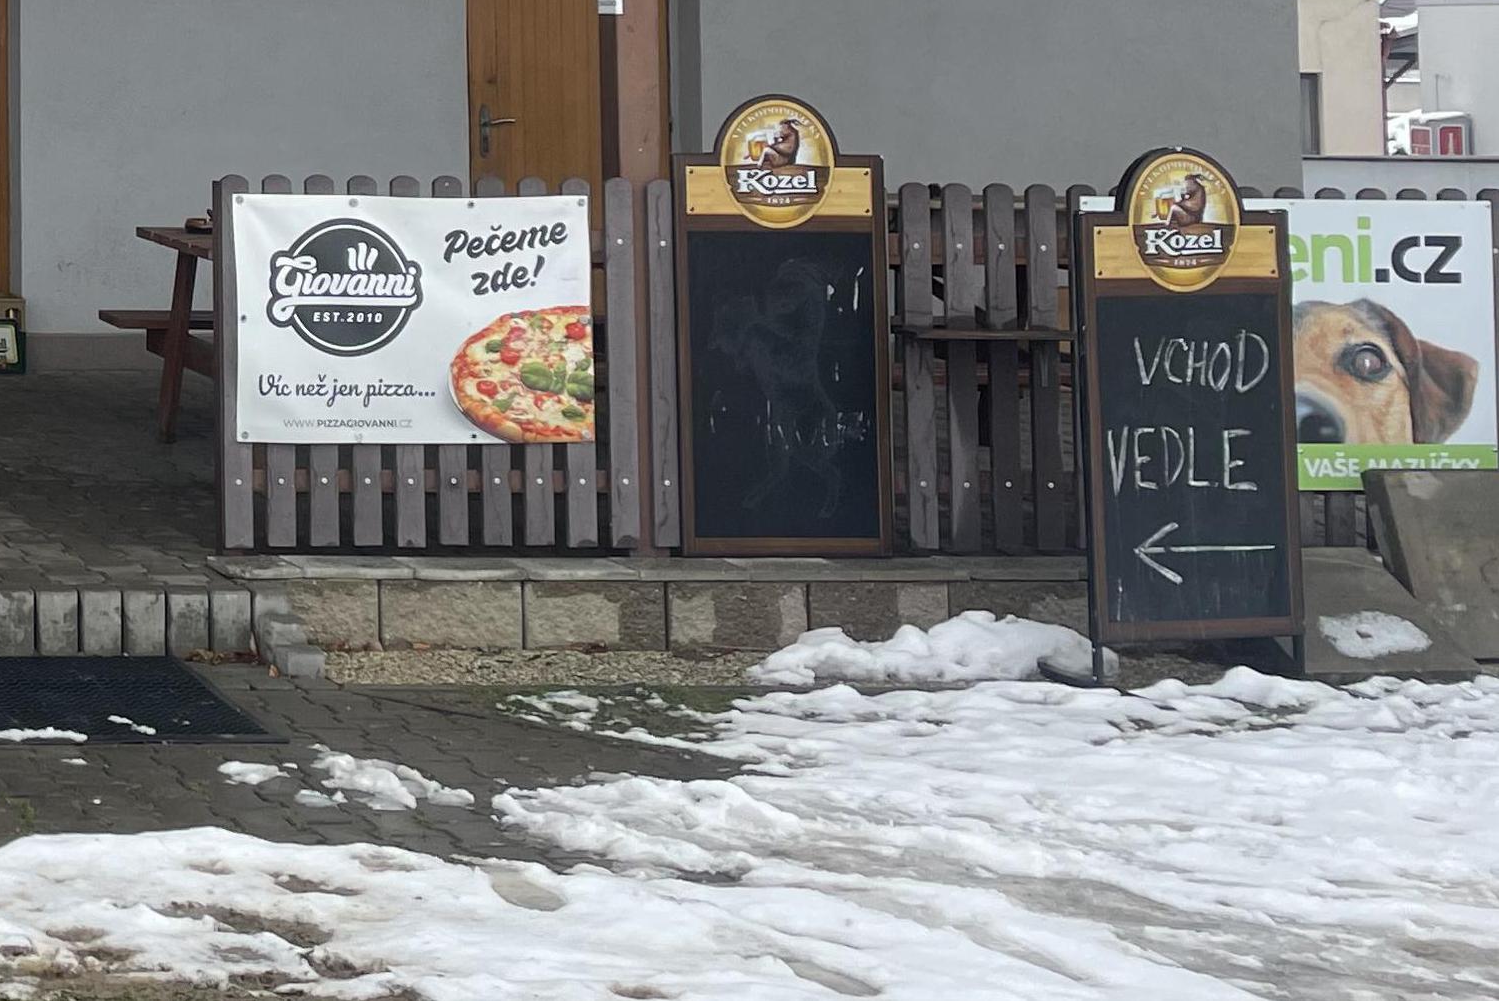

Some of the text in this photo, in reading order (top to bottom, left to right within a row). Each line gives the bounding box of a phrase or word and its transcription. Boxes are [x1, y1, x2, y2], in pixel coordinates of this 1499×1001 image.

[736, 169, 818, 195] Kozel
[443, 221, 569, 264] Pečeme
[1145, 229, 1223, 256] Kozel
[272, 255, 418, 321] Giovanni
[470, 254, 546, 296] zde!
[1133, 329, 1269, 393] VCHOD
[258, 373, 436, 408] Víc než jen pizza...
[1107, 425, 1258, 496] VEDLE
[1304, 452, 1360, 478] VAŠE
